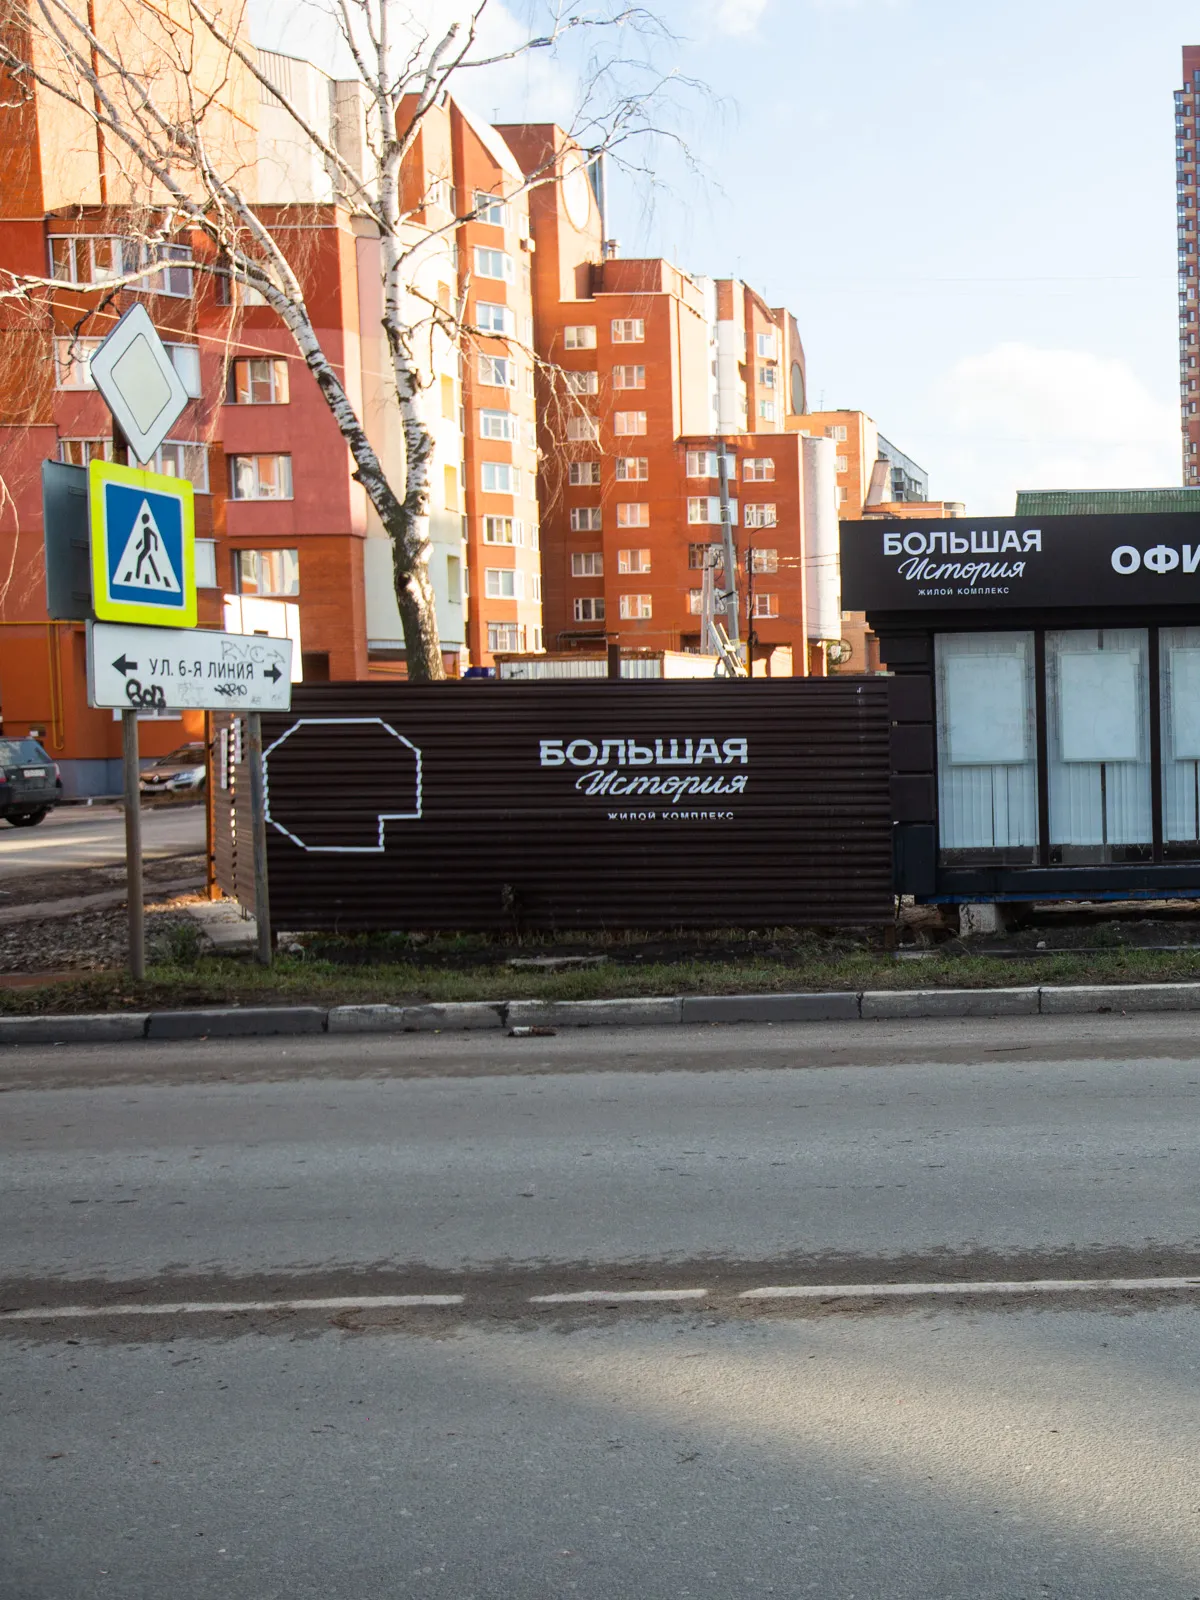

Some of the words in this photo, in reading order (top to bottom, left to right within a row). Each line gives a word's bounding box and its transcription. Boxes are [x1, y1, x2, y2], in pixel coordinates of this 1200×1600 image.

[883, 529, 1042, 556] БОЛЬШАЯ
[897, 557, 1026, 586] История
[918, 587, 953, 596] ЖИЛОЙ
[957, 587, 1010, 595] КОМПЛЕКС
[149, 658, 174, 676] УЛ.
[178, 660, 202, 677] 6-Я
[207, 661, 254, 680] ЛИНИЯ
[539, 738, 749, 766] БОЛЬШАЯ
[575, 770, 749, 803] История
[607, 811, 656, 821] ЖИЛОЙ
[662, 811, 734, 821] КОМПЛЕКС
